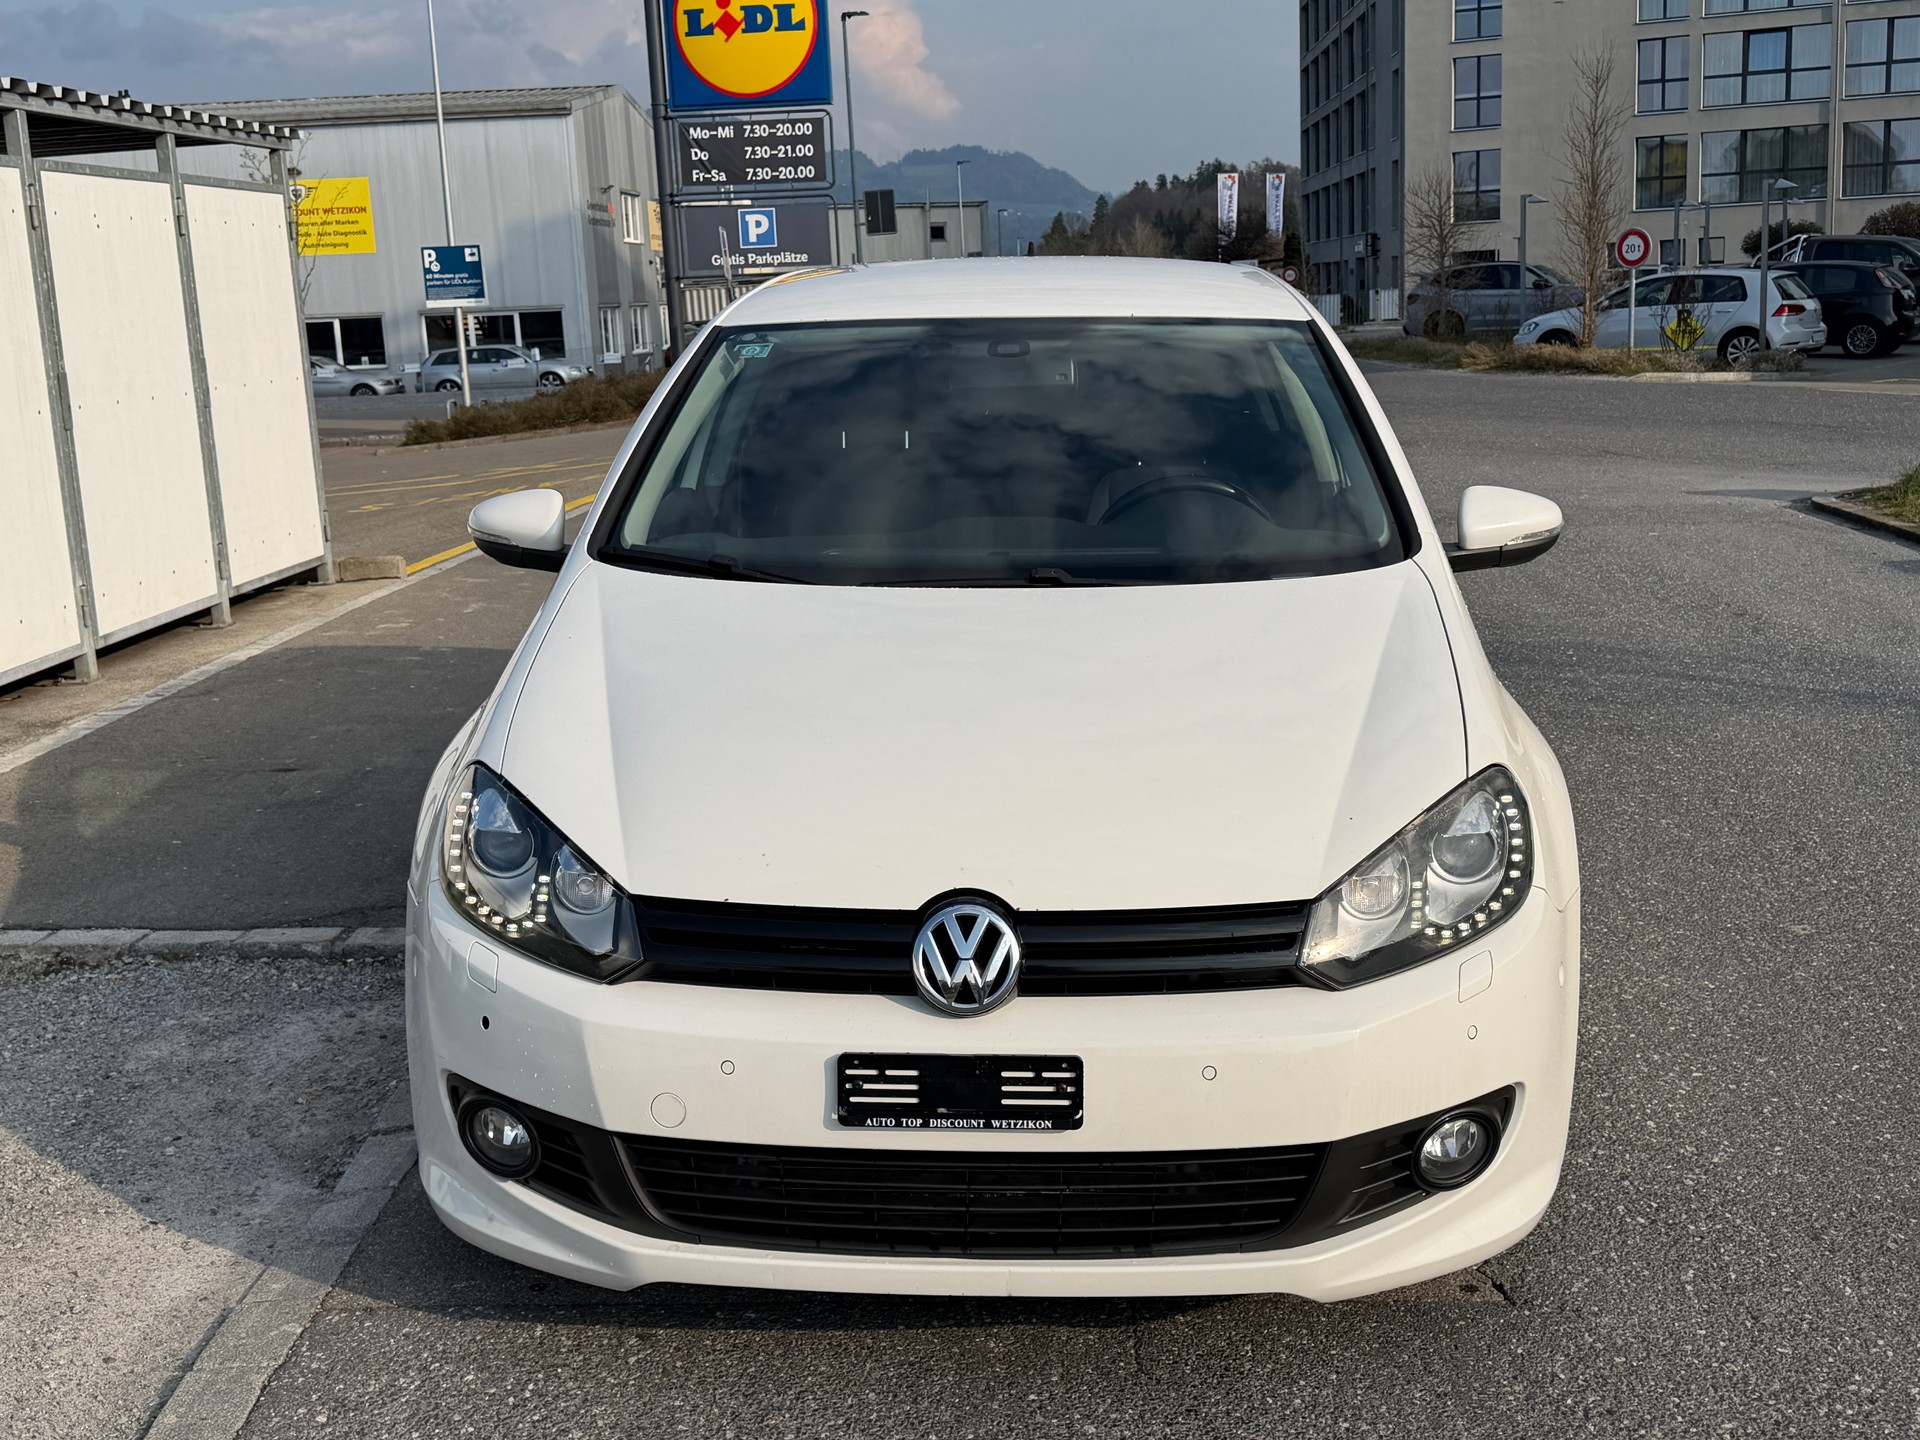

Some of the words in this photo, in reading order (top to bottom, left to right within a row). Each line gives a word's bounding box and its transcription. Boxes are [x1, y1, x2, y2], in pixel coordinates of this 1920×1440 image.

[689, 125, 735, 139] Mo-Mi
[743, 122, 813, 138] 7.30-20.00
[690, 148, 709, 161] Do
[744, 144, 814, 159] 7.30-21.00
[692, 169, 727, 182] Fr-Sa
[745, 165, 815, 181] 7.30-20.00
[322, 206, 367, 215] WETZIKON
[744, 212, 770, 243] P
[1625, 243, 1636, 253] 20
[1637, 244, 1642, 253] t
[748, 252, 808, 268] Parkplätze
[864, 1117, 896, 1127] AUTO
[900, 1118, 923, 1127] TOP
[929, 1118, 985, 1128] DISCOUNT
[990, 1119, 1052, 1129] WETZIKON
